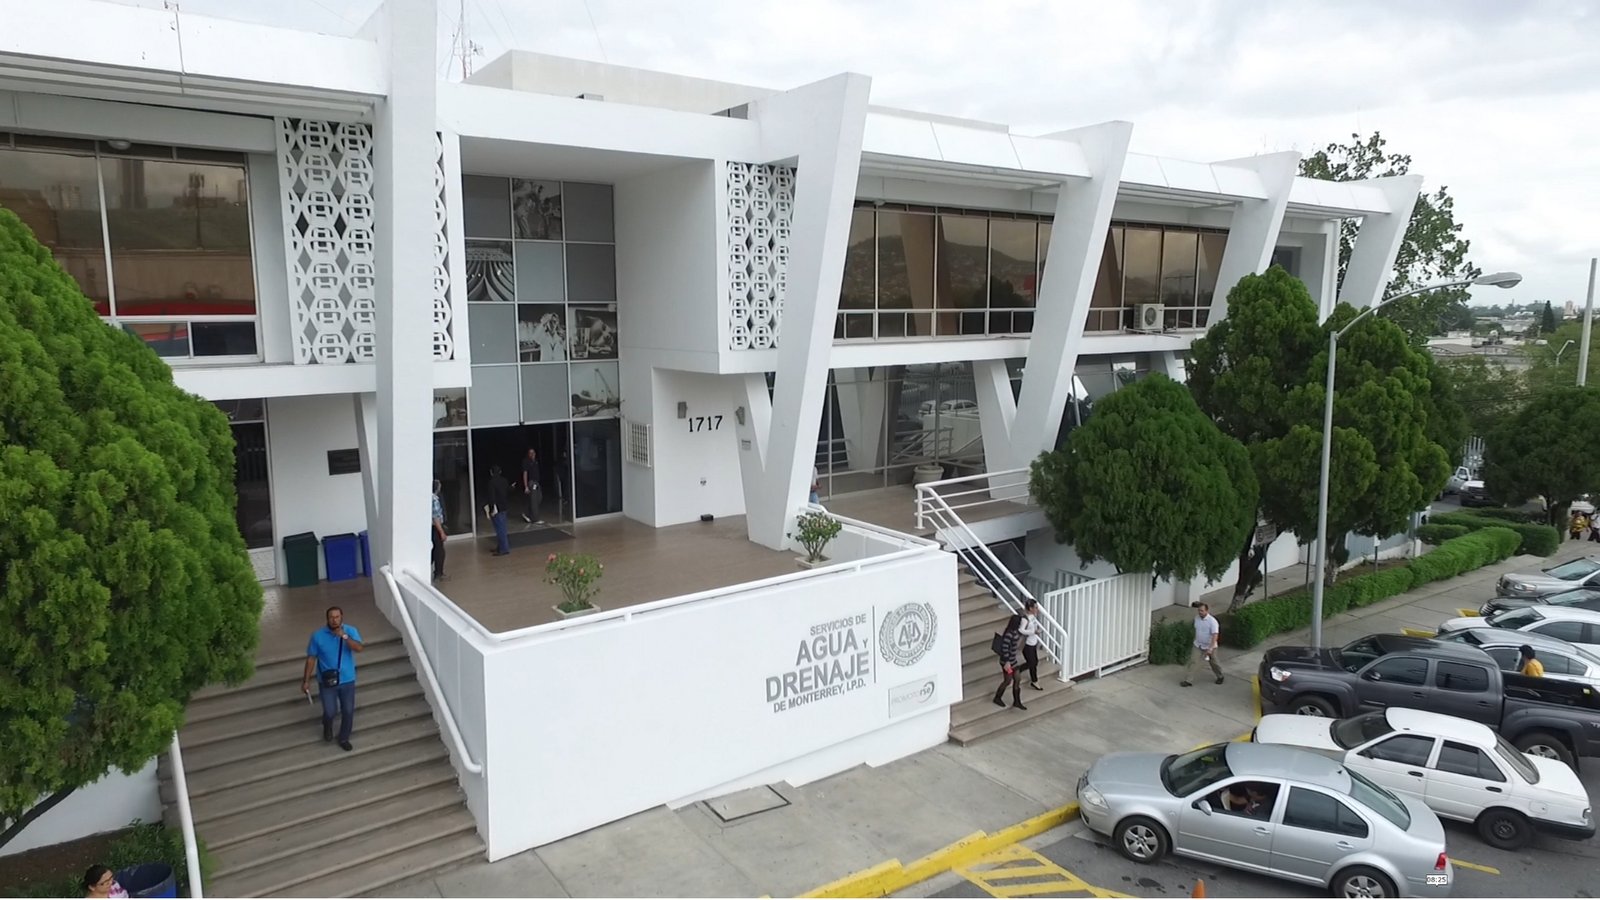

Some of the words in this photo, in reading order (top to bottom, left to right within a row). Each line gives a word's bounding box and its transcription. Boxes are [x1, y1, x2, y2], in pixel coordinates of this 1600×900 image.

[689, 415, 723, 432] 1717
[810, 617, 854, 636] SERVICIOS
[855, 613, 866, 625] DE
[796, 628, 858, 666] AGUA
[862, 638, 869, 649] Y
[766, 651, 869, 702] DRENAJE
[773, 701, 786, 713] DE
[788, 684, 845, 709] MONTERREY,
